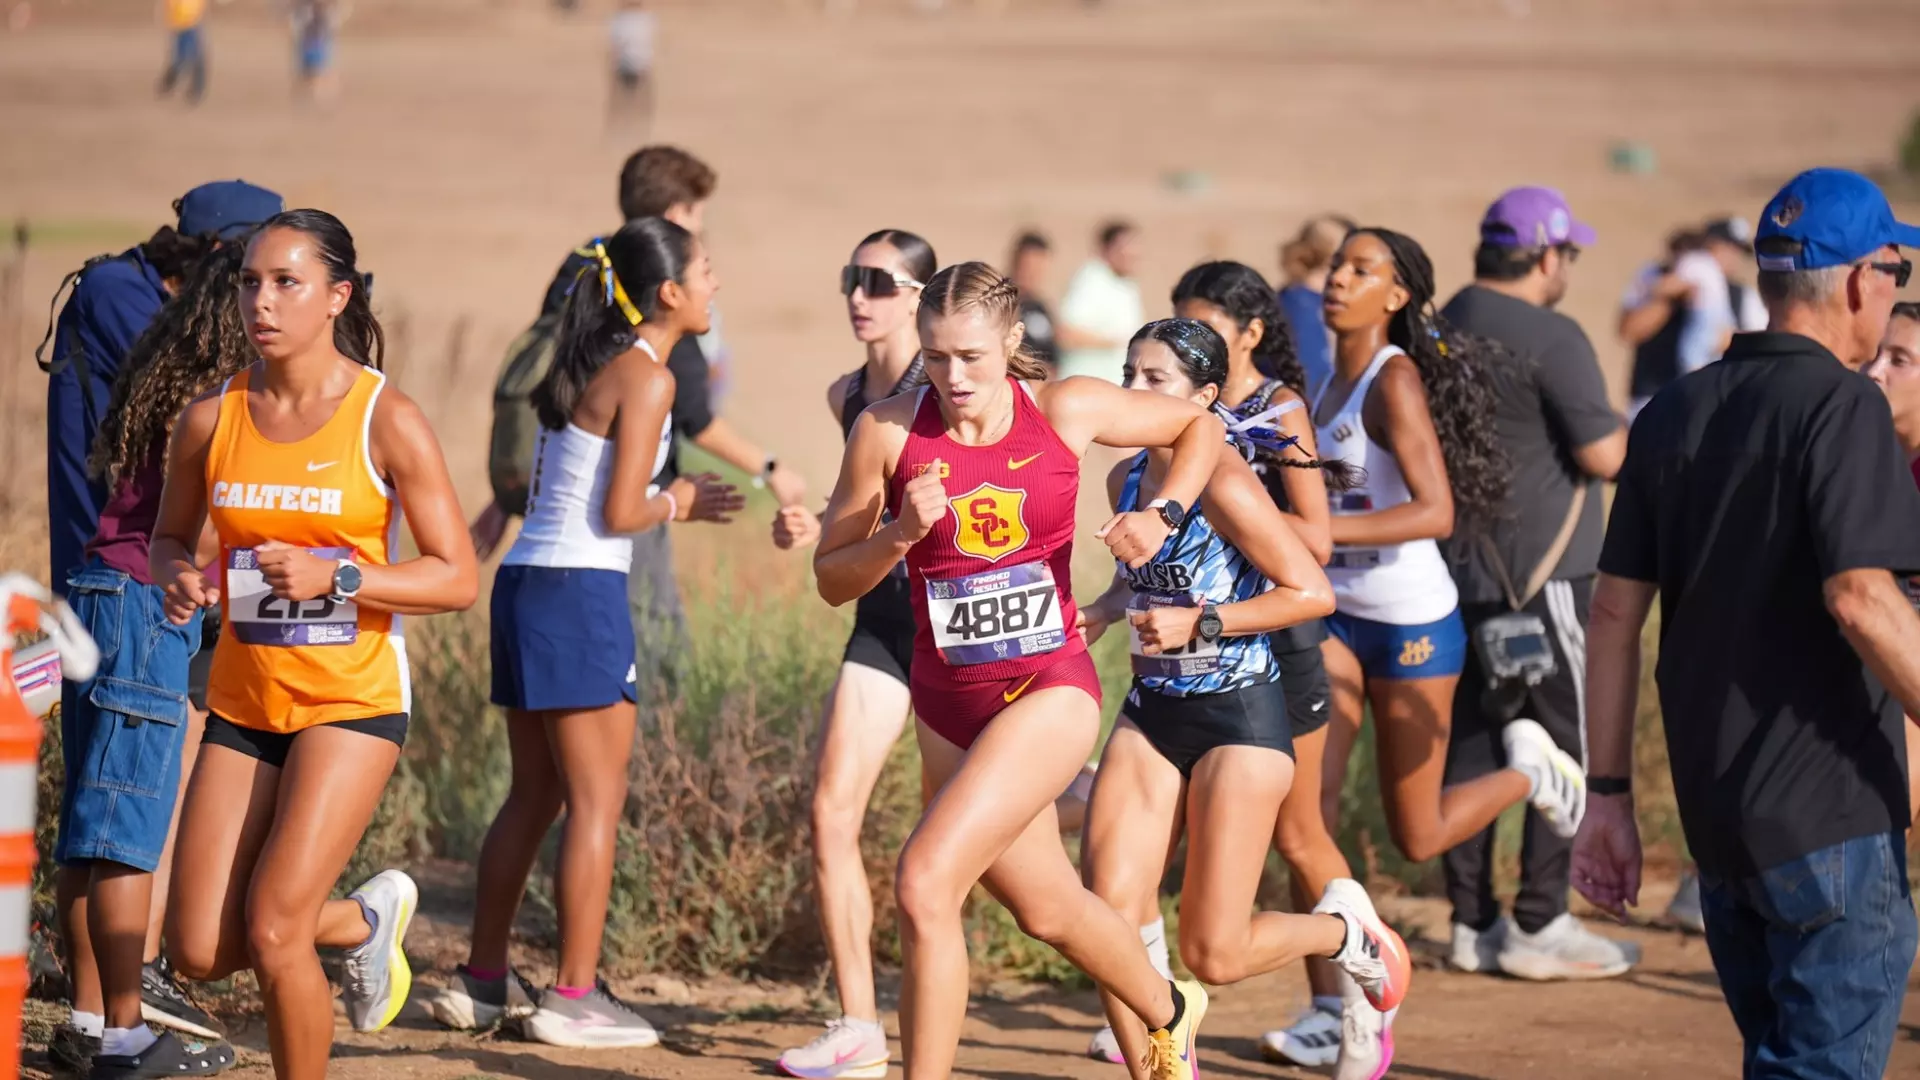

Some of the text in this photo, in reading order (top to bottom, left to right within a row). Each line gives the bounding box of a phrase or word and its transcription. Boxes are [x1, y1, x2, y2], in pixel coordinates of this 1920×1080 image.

[213, 481, 342, 515] CALTECH
[970, 497, 1010, 548] SC
[973, 571, 1010, 585] FINISHED
[973, 580, 1010, 595] RESULTS
[946, 587, 1056, 640] 4887
